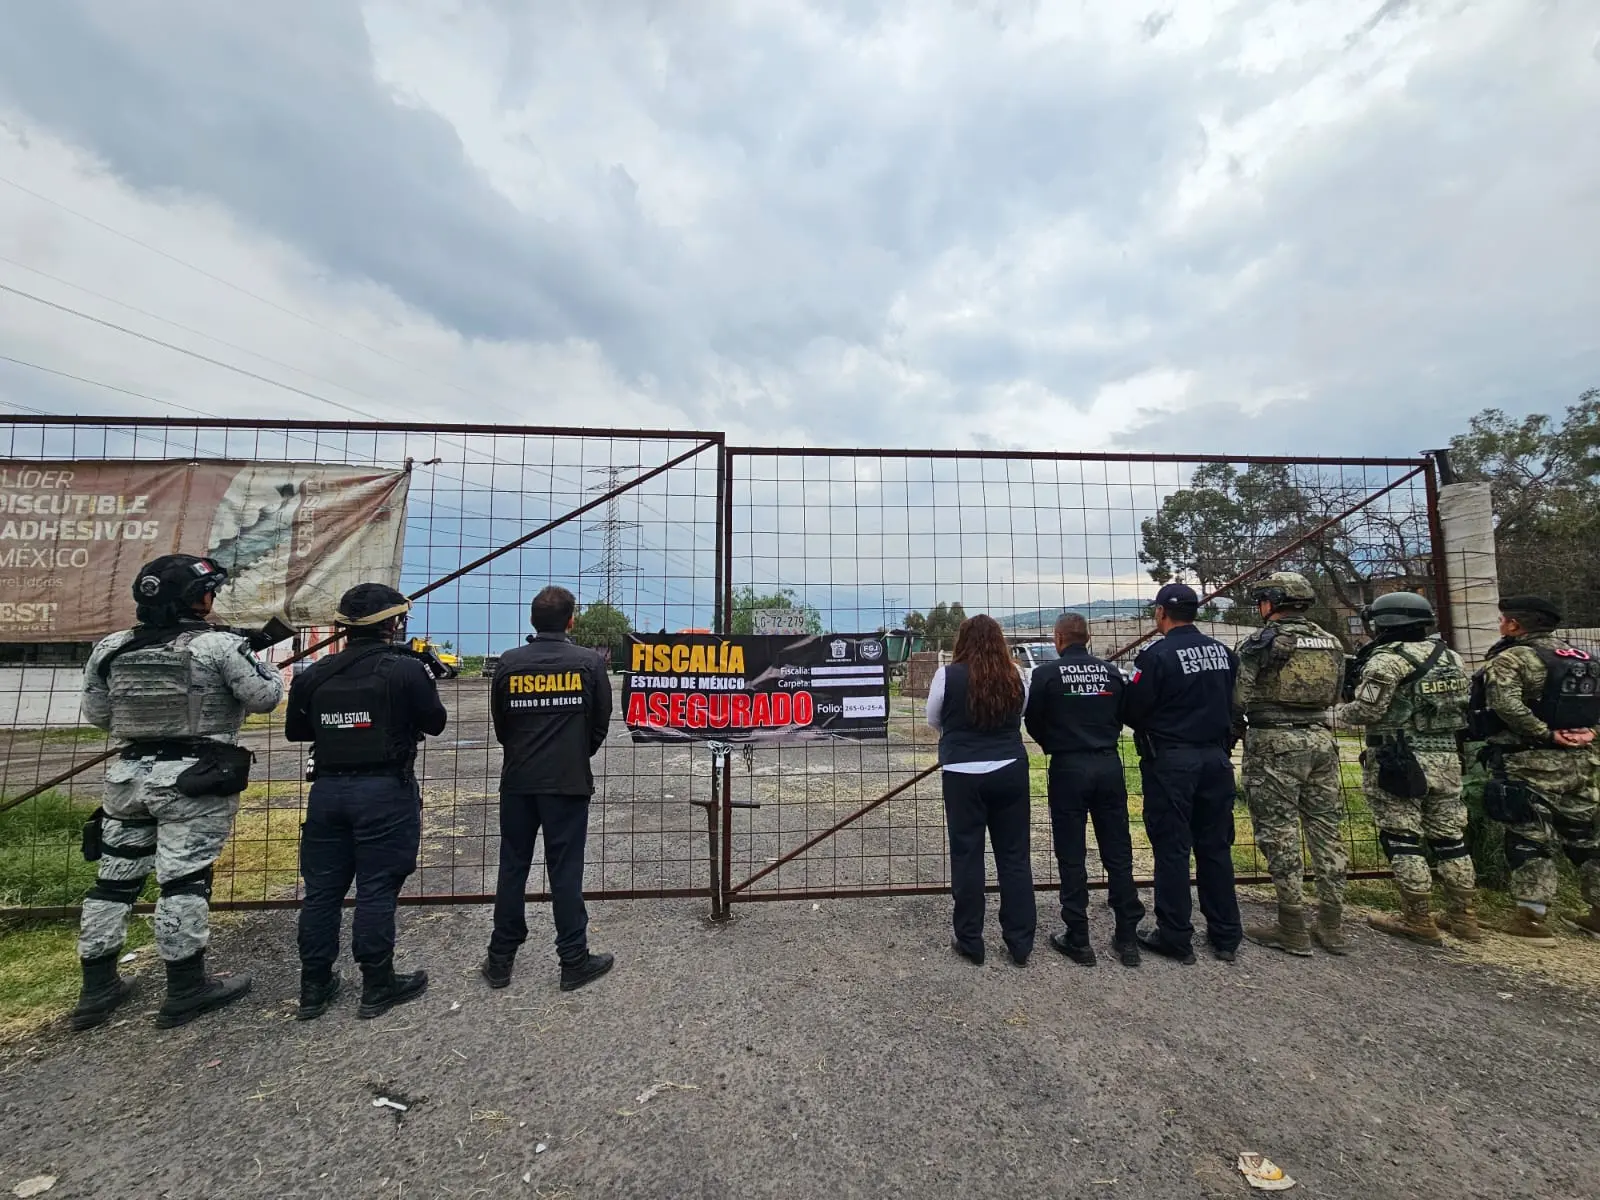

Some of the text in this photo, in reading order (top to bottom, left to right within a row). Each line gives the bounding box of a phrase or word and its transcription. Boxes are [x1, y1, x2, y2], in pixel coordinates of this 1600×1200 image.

[2, 465, 74, 489] LÍDER
[0, 520, 160, 541] ADHESIVOS
[0, 543, 89, 568] MÉXICO
[863, 644, 878, 652] FGJ
[1175, 643, 1229, 662] POLICÍA
[631, 640, 745, 674] FISCALÍA
[1058, 663, 1109, 674] POLICÍA
[1180, 657, 1230, 675] ESTATAL
[509, 671, 583, 694] FISCALÍA
[630, 675, 745, 690] ESTADO DE MÉXICO
[777, 679, 811, 689] Carpeta:
[1061, 673, 1111, 684] MUNICIPAL
[1070, 683, 1106, 693] LA PAZ
[510, 696, 583, 708] ESTADO DE MÉXICO
[626, 690, 814, 728] ASEGURADO
[816, 703, 843, 714] Folio:
[320, 711, 372, 725] POLICÍA ESTATAL
